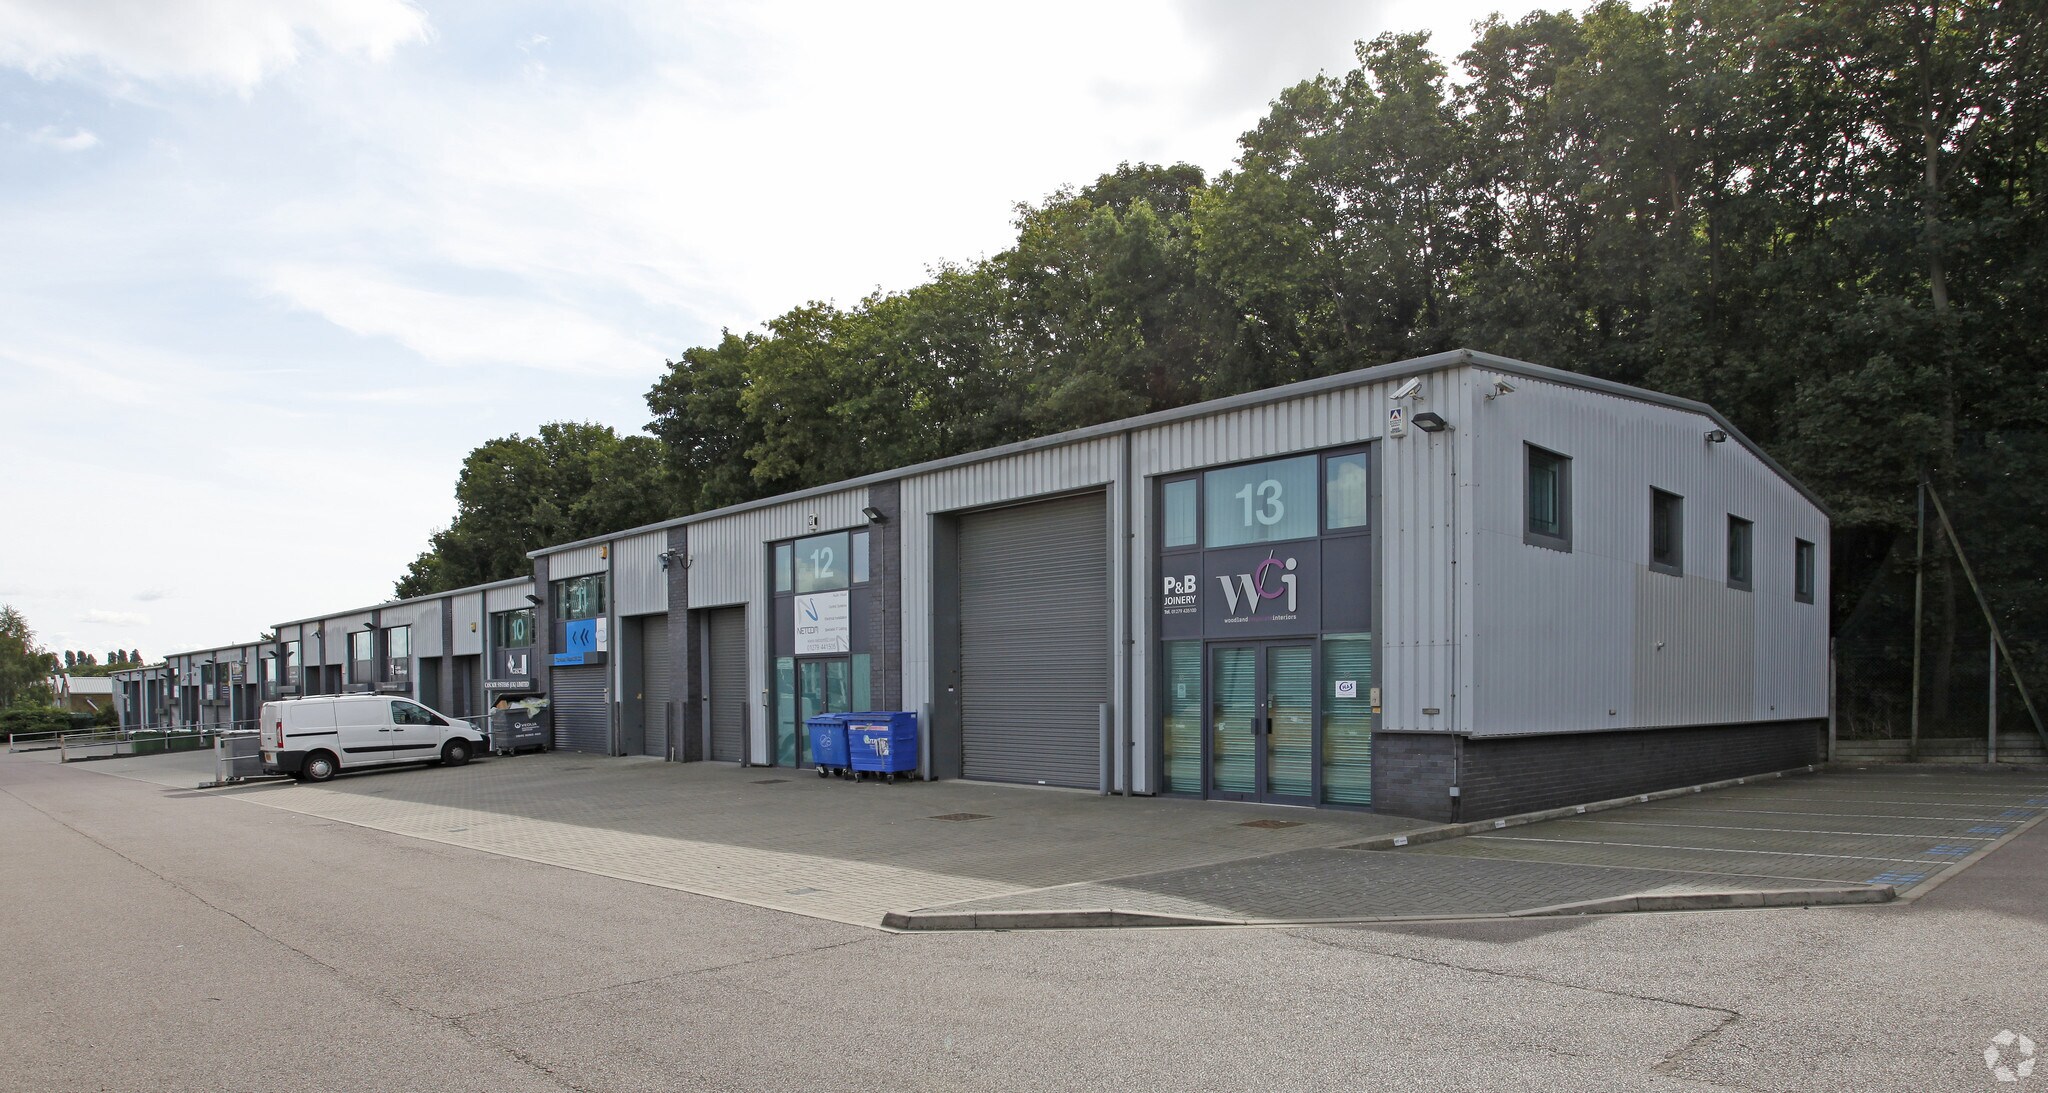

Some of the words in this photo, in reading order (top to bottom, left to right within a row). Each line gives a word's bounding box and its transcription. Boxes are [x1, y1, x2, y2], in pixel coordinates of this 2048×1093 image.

[1235, 479, 1284, 526] 13
[810, 547, 833, 579] 12
[1164, 575, 1196, 595] P&B
[1164, 595, 1196, 605] JOINERY
[512, 618, 524, 641] 10
